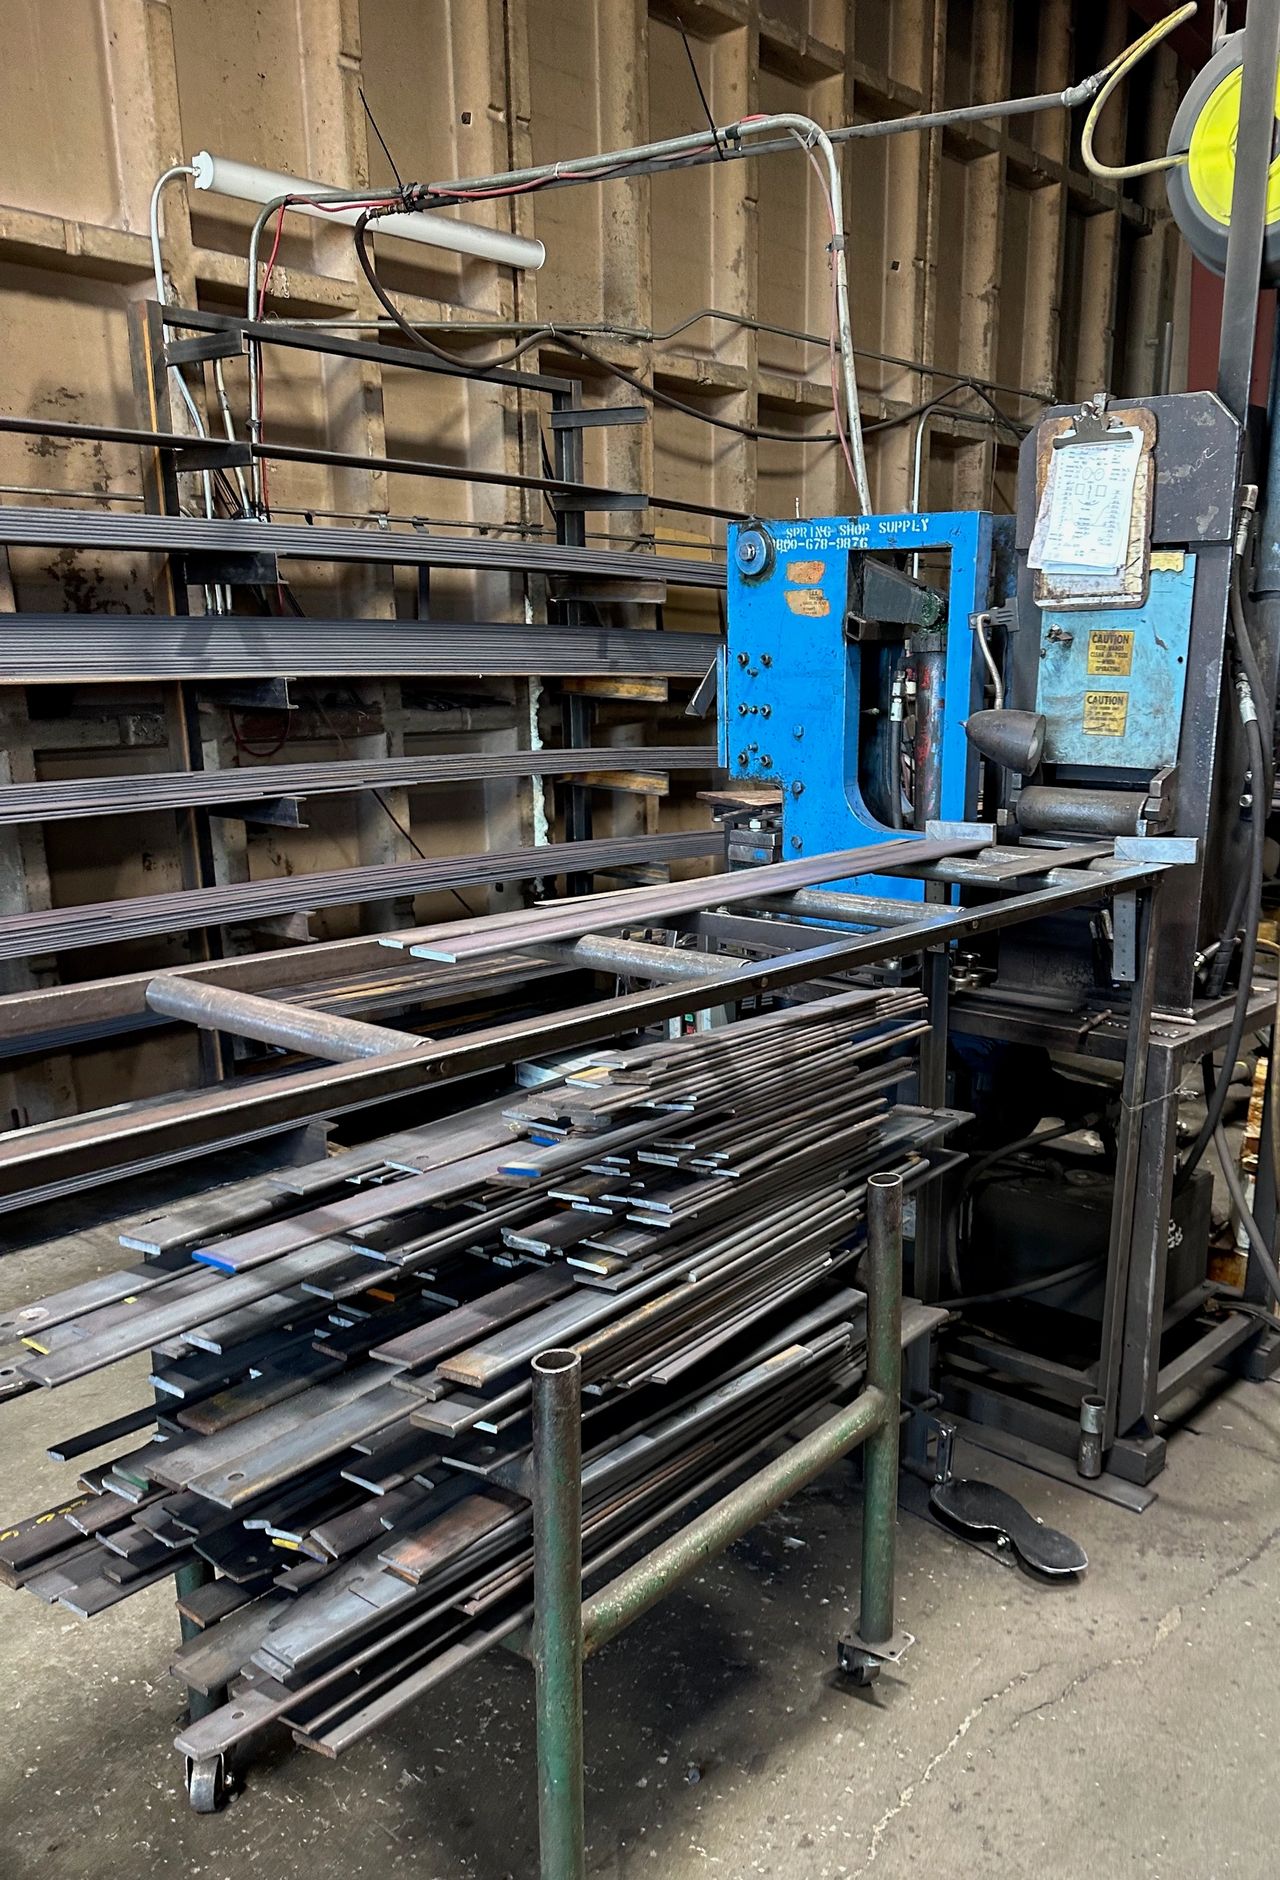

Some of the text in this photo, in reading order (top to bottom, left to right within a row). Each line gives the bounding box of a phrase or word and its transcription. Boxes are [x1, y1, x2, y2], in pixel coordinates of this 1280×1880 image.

[786, 518, 929, 539] SPRING SHOP SUPPLY
[773, 537, 869, 551] 800-678-9876
[1092, 634, 1130, 644] CAUTION
[1087, 695, 1124, 706] CAUTION
